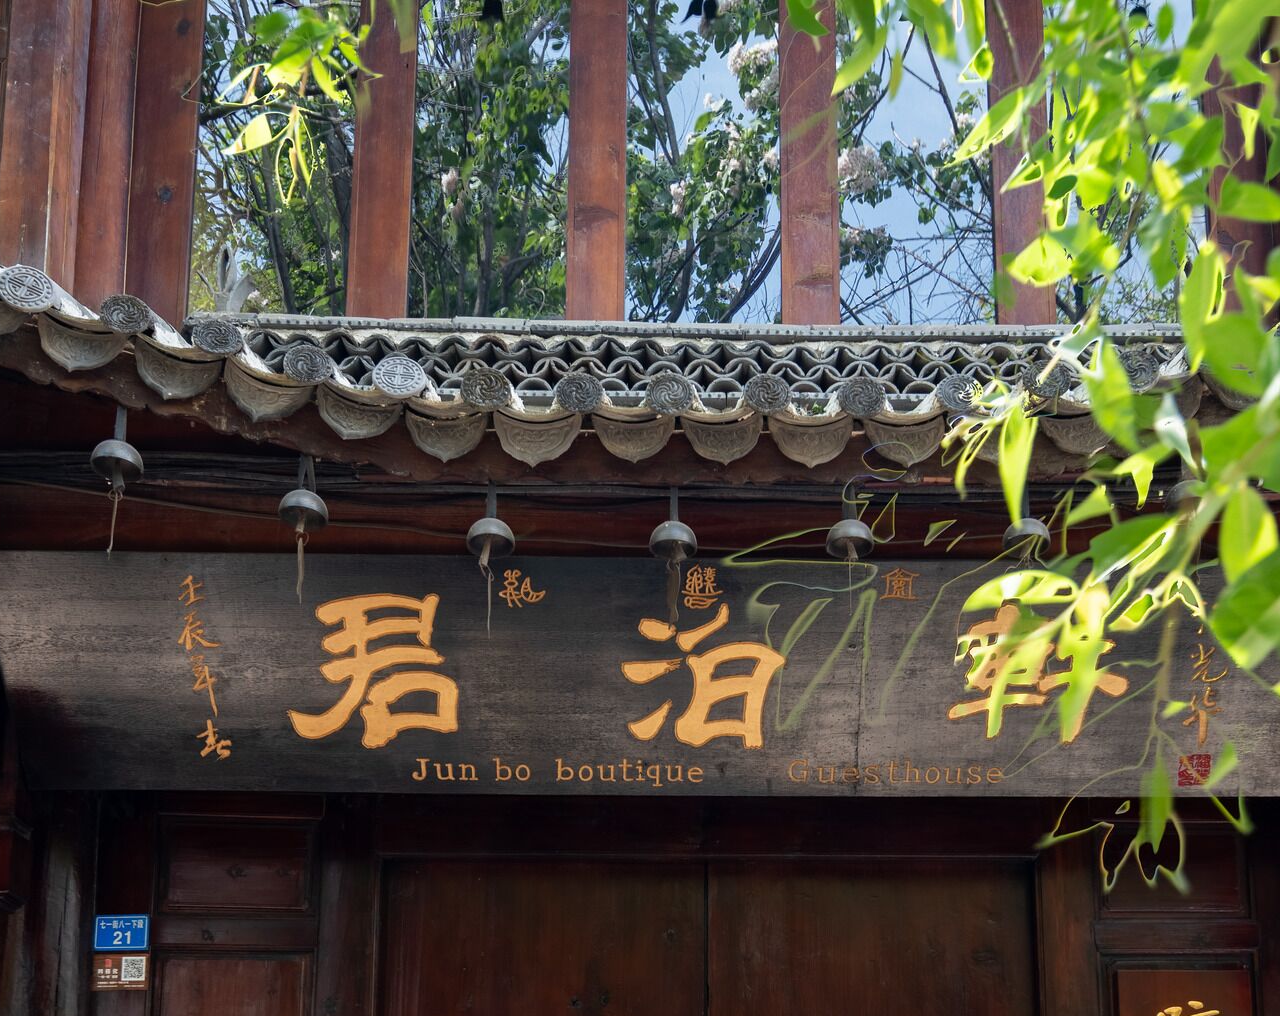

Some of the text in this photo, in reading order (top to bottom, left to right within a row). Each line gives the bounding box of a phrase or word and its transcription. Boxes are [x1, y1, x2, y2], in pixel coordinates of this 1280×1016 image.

[411, 757, 1005, 787] Jun bo boutique Guesthouse
[112, 931, 132, 945] 21
